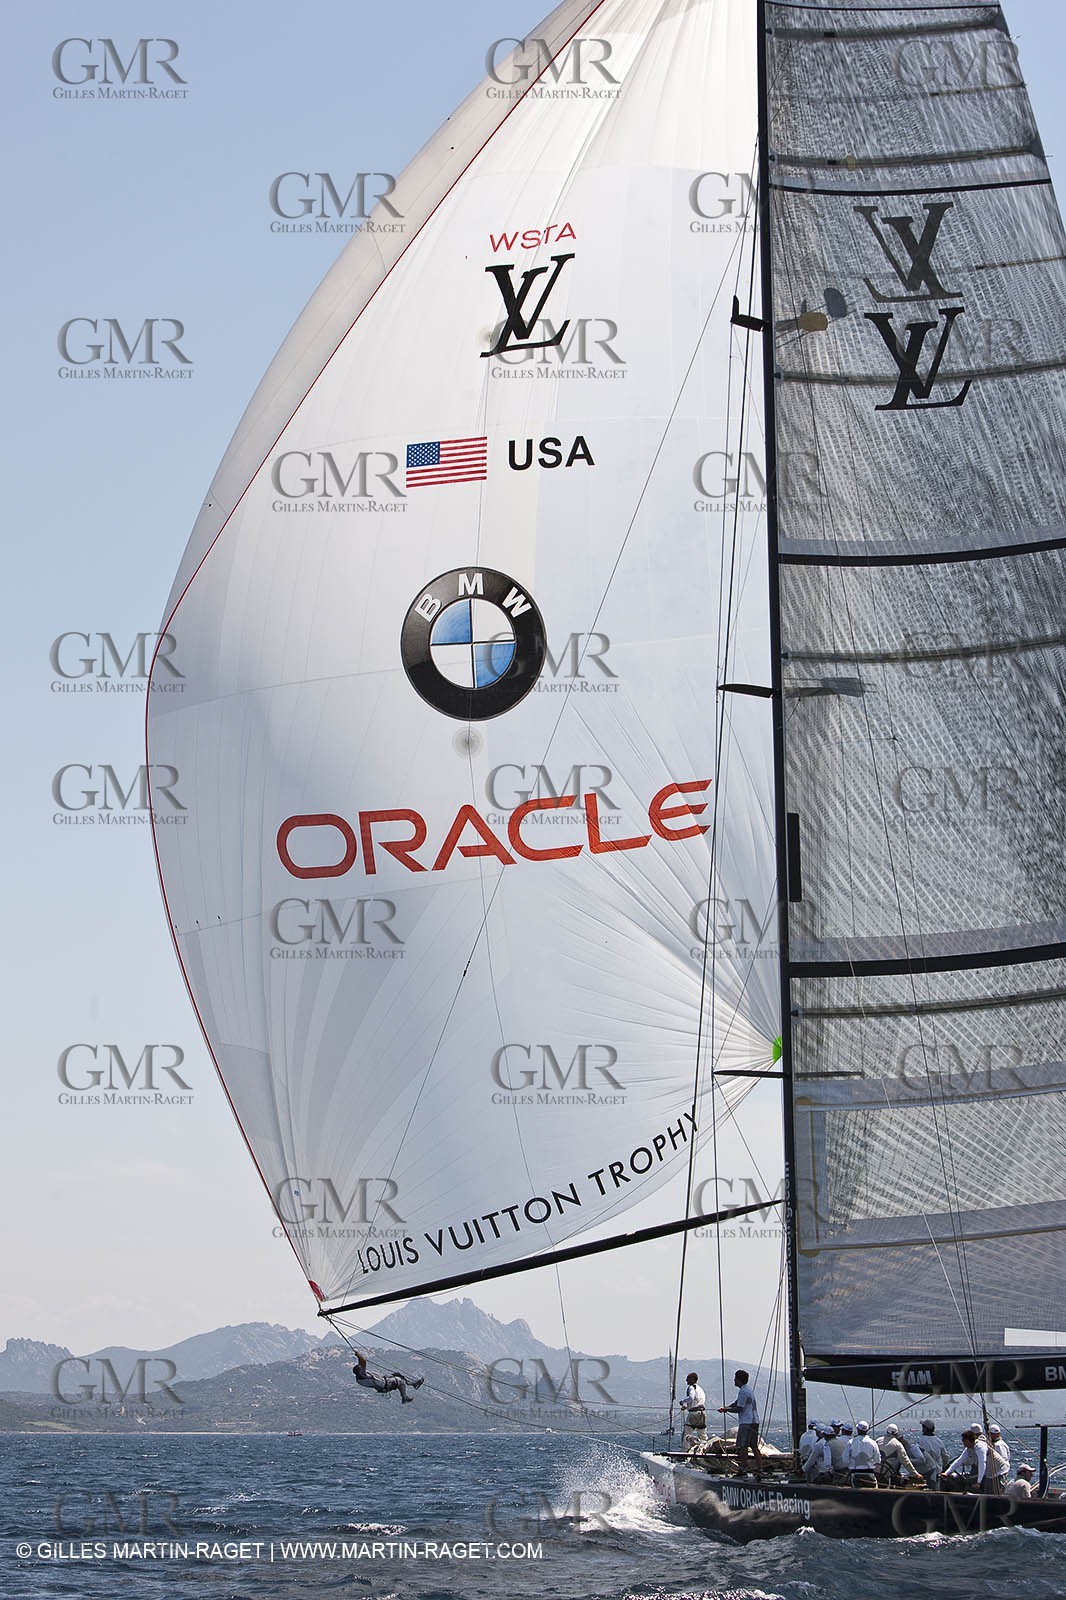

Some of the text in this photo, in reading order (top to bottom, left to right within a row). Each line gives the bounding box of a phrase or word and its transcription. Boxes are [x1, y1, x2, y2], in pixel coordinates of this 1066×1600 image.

[489, 222, 577, 252] WSTA
[508, 436, 595, 471] USA
[414, 572, 532, 622] BMW
[276, 778, 713, 879] ORACLE
[357, 1104, 700, 1274] LOUIS VUITTON TROPHY
[722, 1485, 811, 1520] BMW ORACLE Racing
